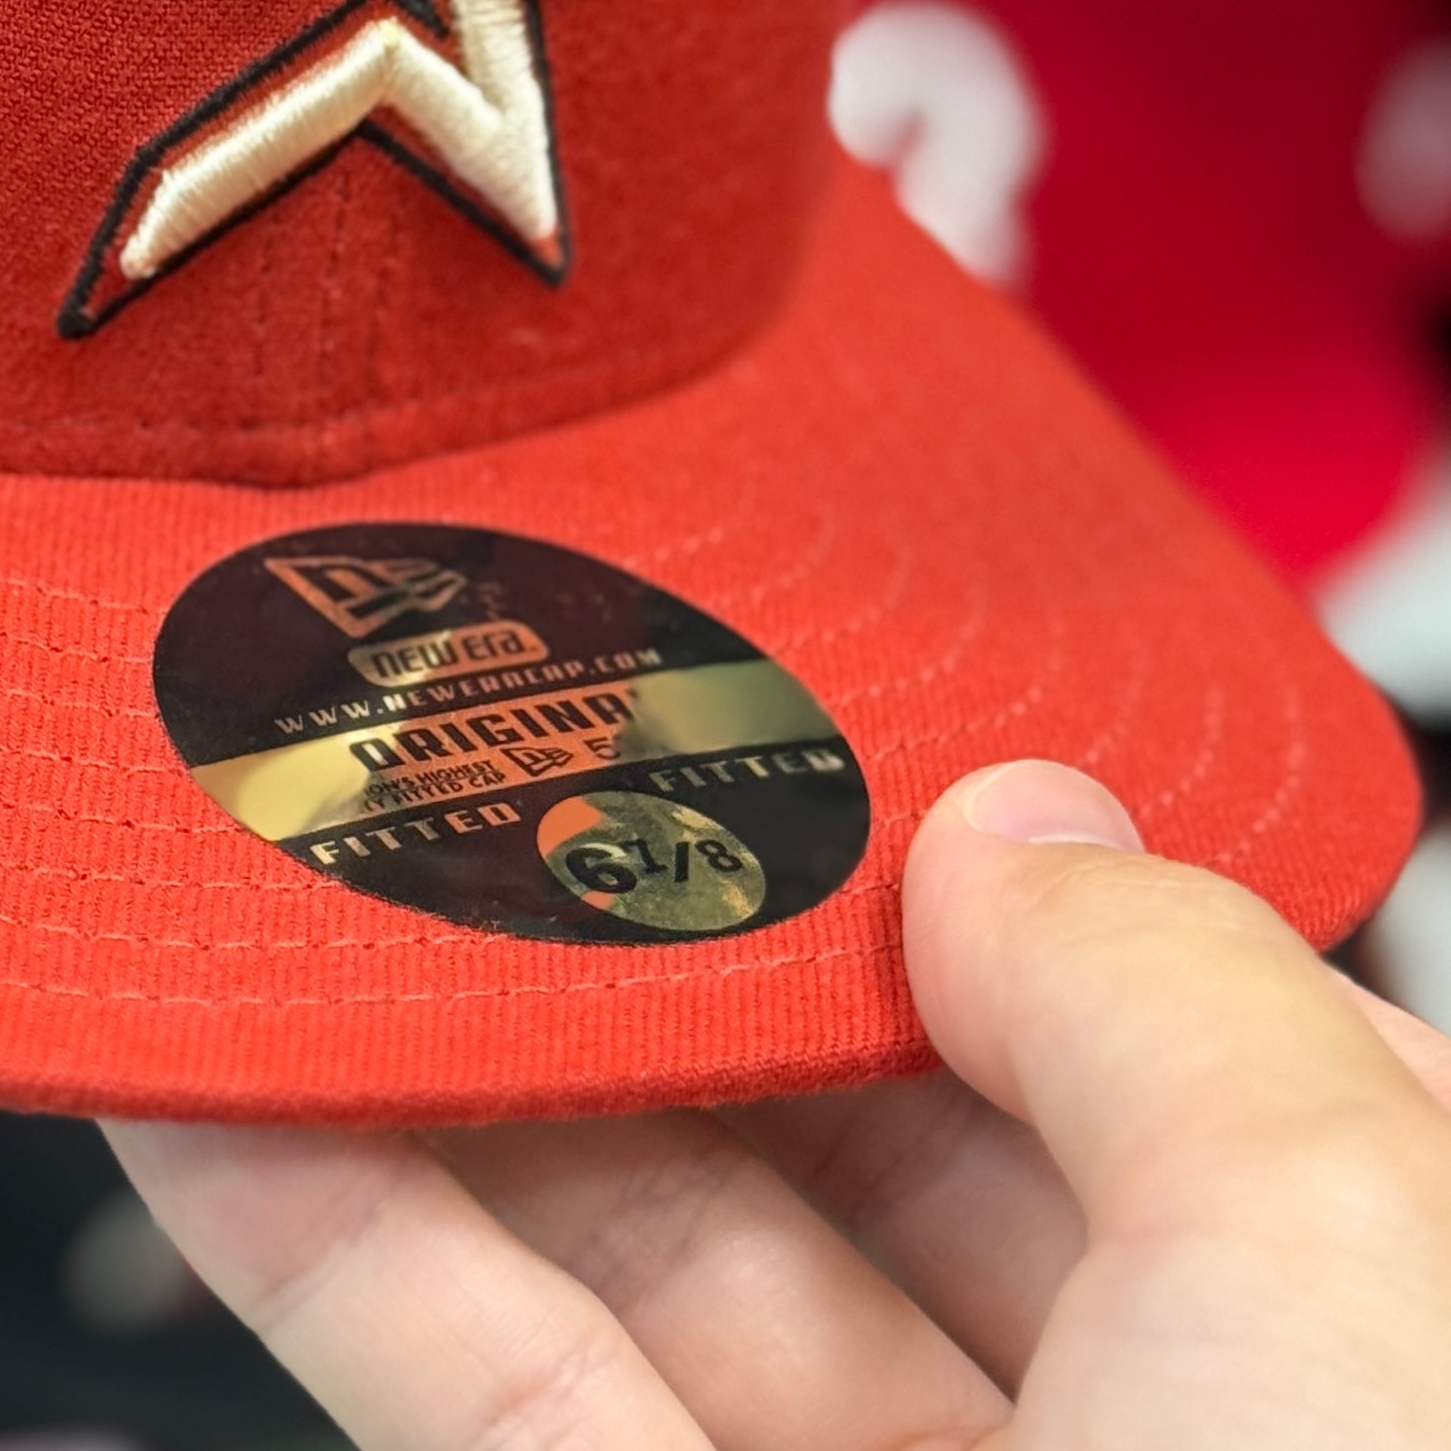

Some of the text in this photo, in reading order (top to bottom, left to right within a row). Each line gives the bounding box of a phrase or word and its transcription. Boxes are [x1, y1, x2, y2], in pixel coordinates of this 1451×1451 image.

[349, 687, 639, 771] ORIGINA
[649, 749, 846, 792] FITTED
[310, 802, 522, 865] FITTED
